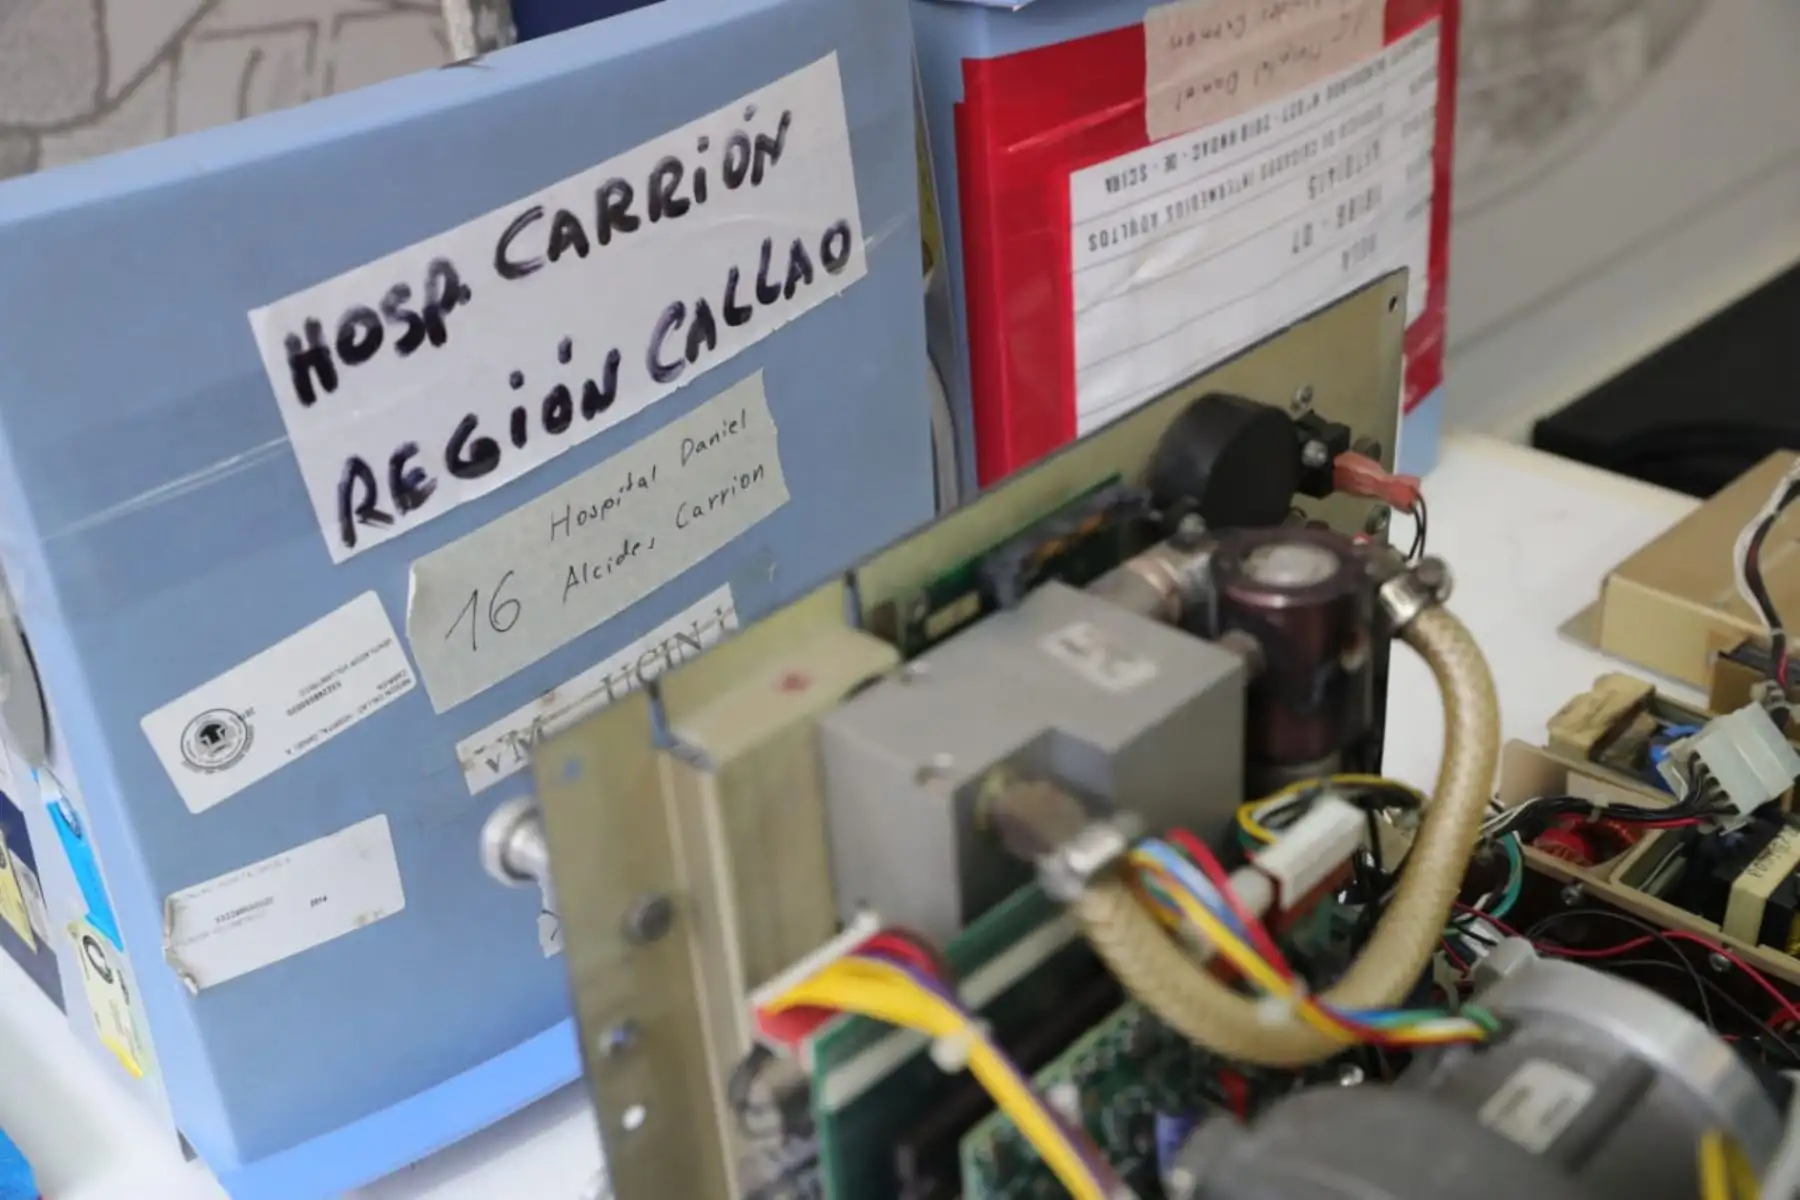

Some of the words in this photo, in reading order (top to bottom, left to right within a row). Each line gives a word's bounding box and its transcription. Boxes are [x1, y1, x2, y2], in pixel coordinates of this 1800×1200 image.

[1088, 211, 1158, 252] ADULTOS
[645, 218, 852, 384] CALLAO
[550, 464, 657, 541] Hospital
[681, 408, 748, 467] Daniel
[563, 536, 656, 605] Alcides
[676, 463, 765, 531] Carrion
[444, 570, 522, 653] 16
